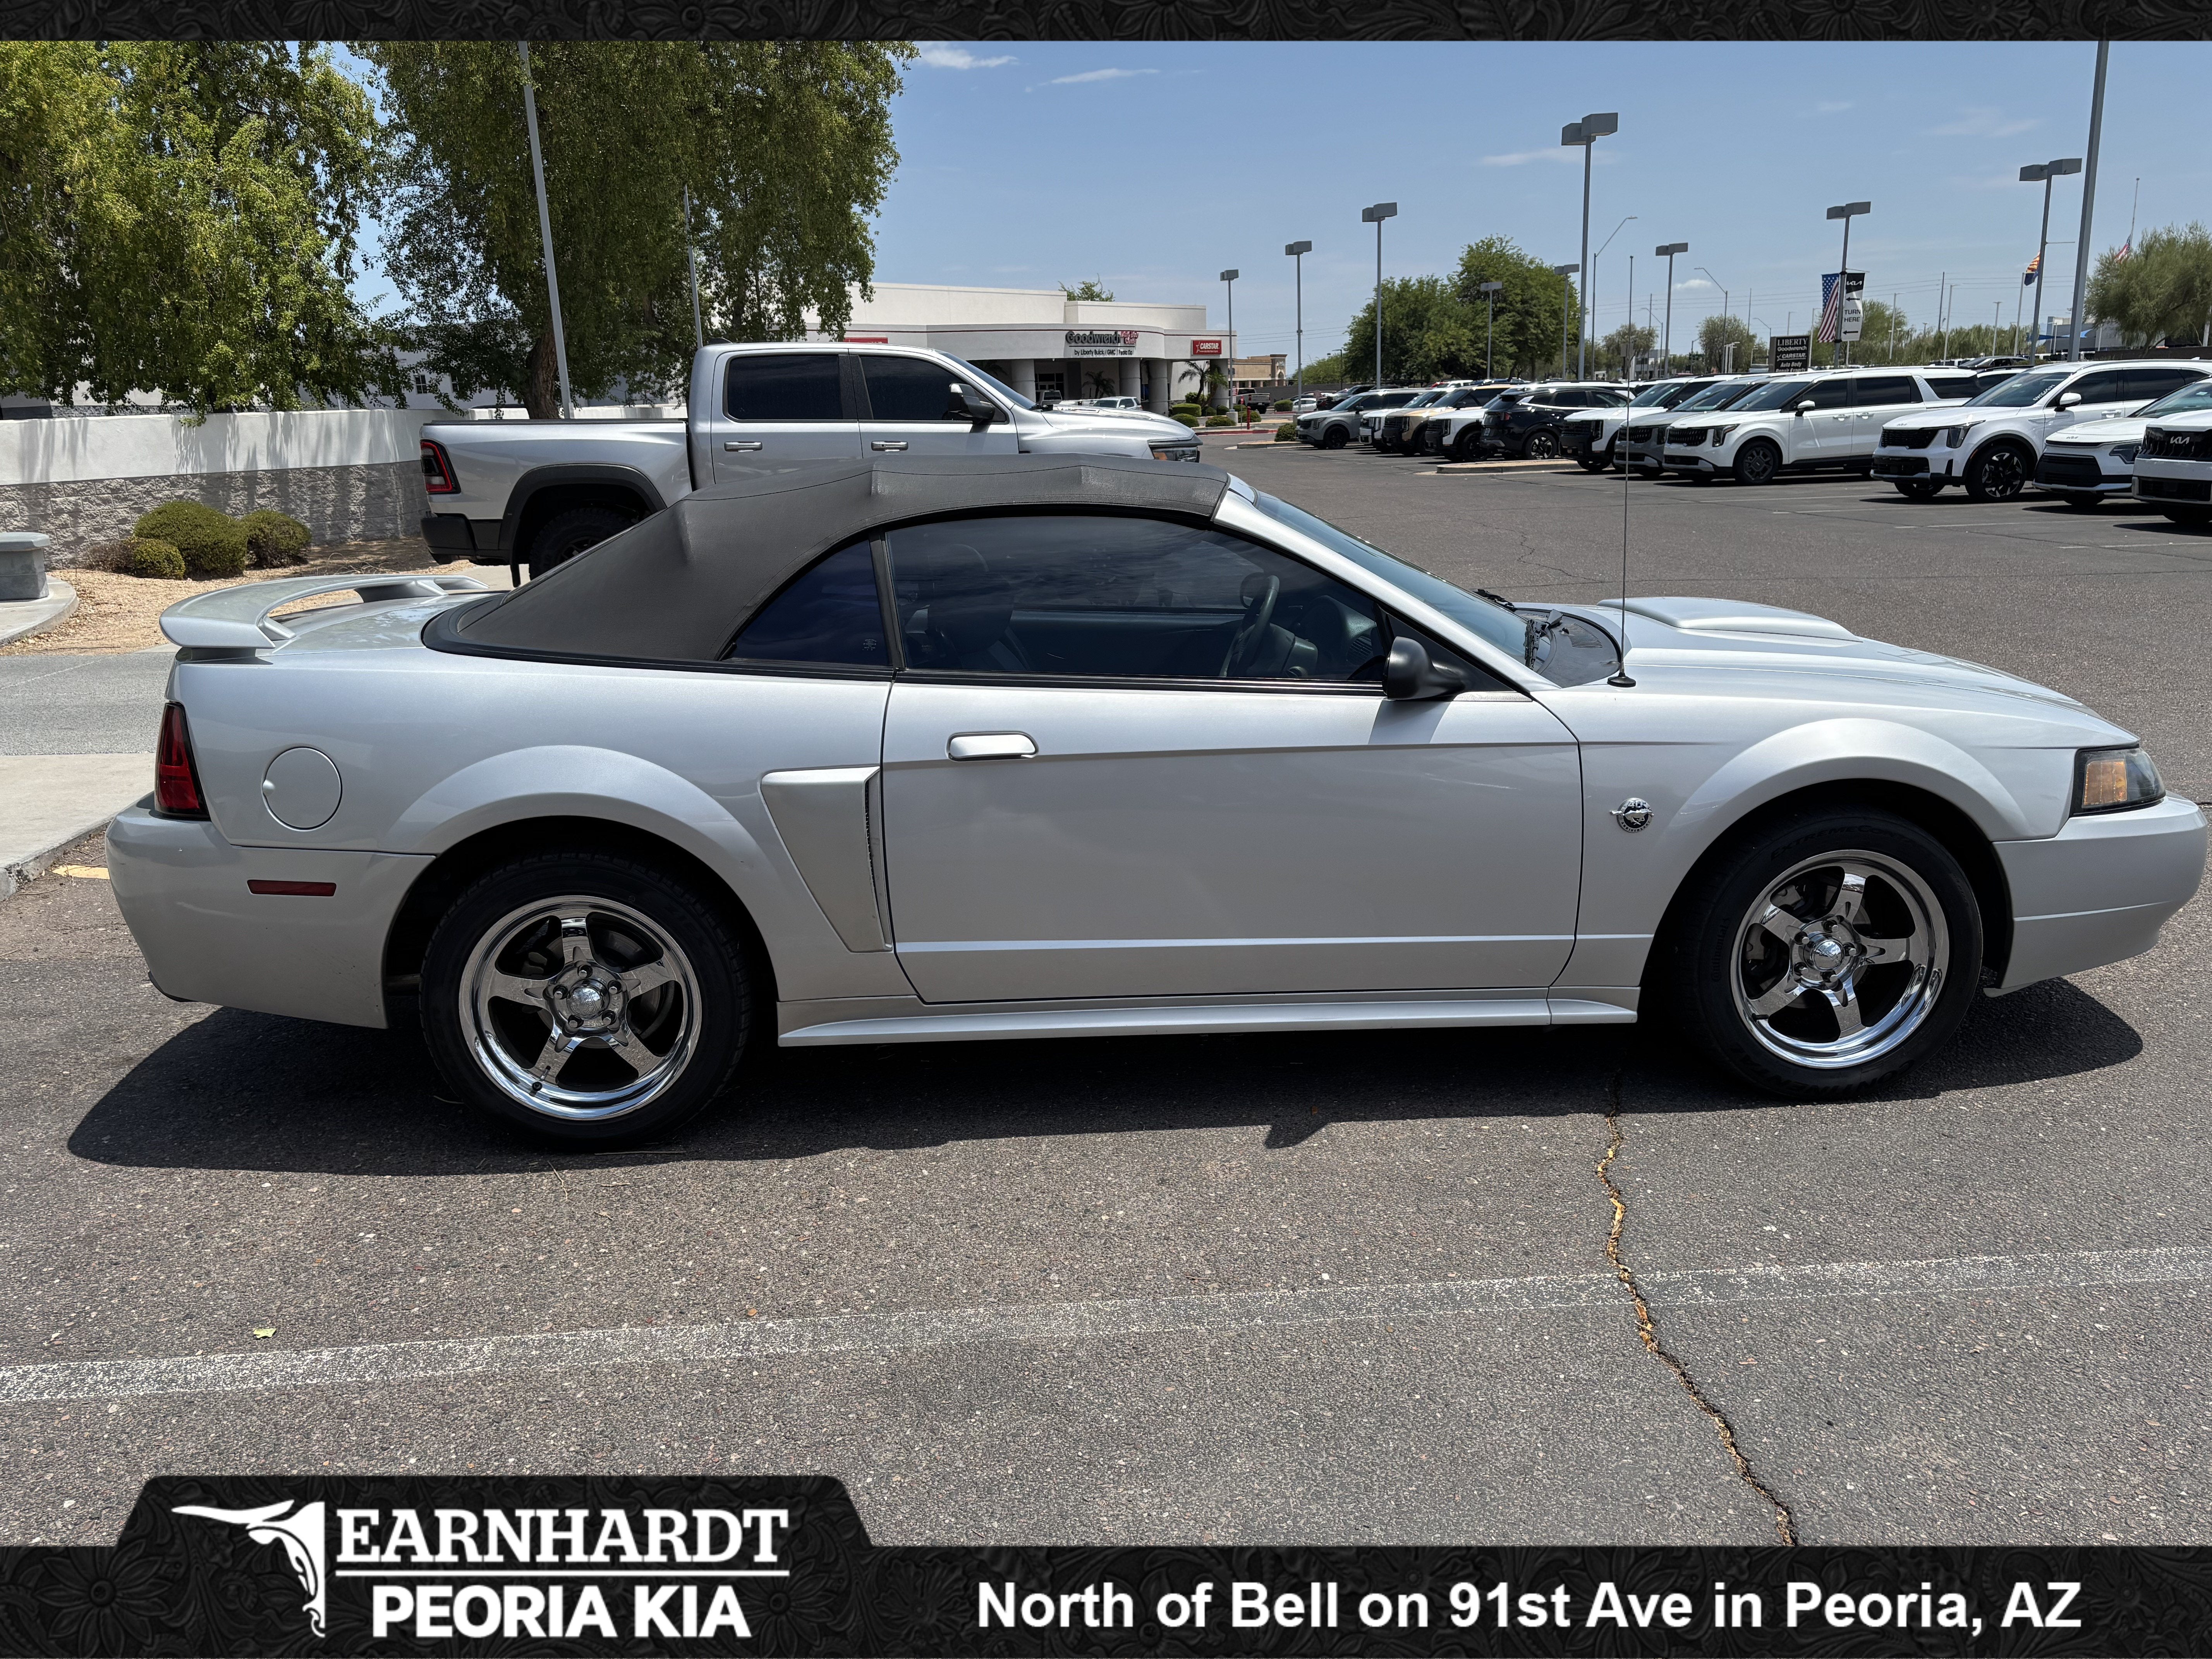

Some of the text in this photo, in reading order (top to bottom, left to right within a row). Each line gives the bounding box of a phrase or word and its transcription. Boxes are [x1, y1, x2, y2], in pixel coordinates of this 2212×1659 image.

[1065, 331, 1121, 344] Goodwrench
[2170, 436, 2190, 444] KIA
[1711, 924, 1729, 982] Continental
